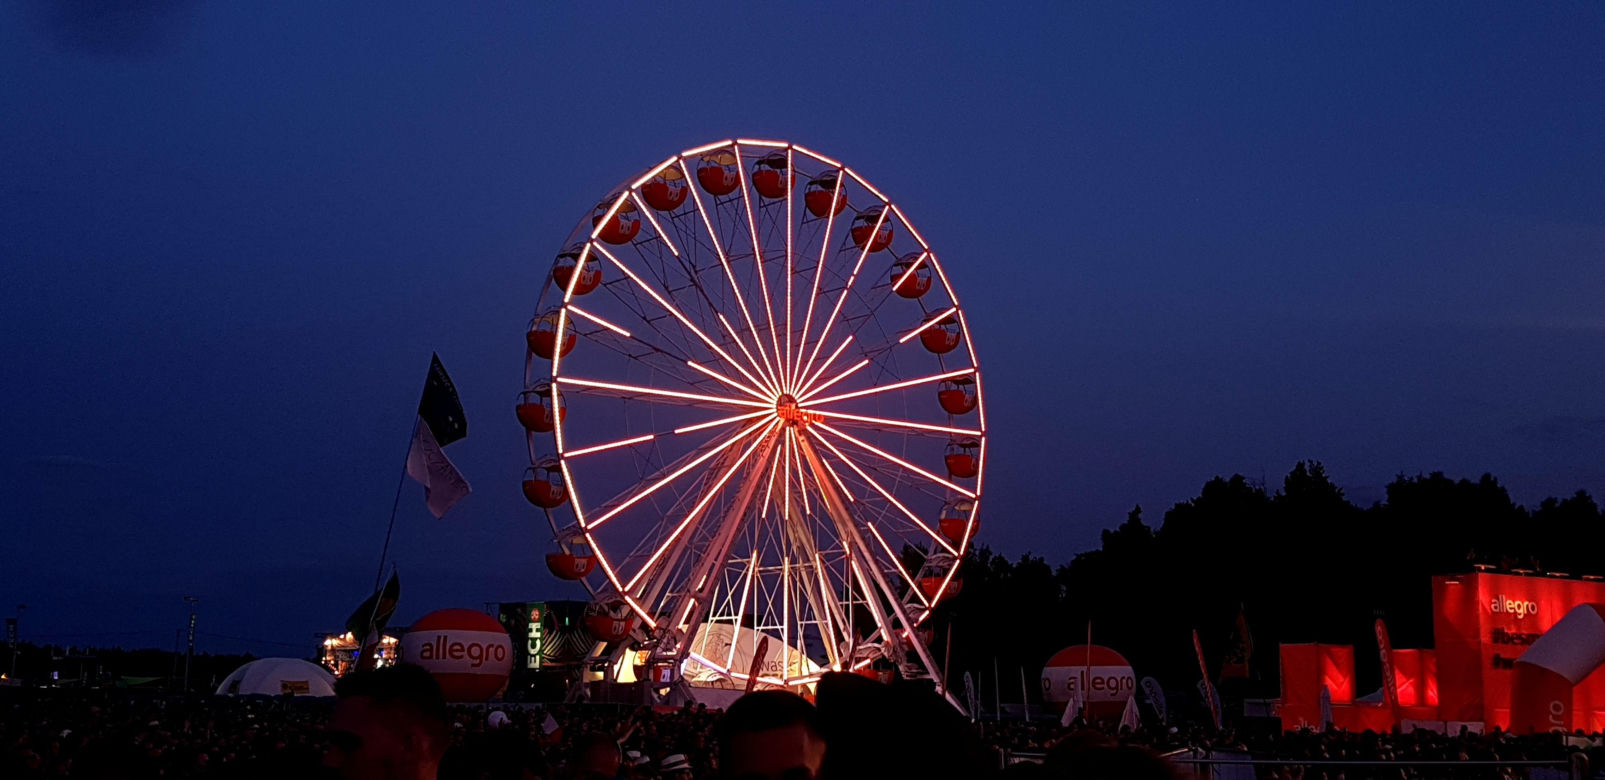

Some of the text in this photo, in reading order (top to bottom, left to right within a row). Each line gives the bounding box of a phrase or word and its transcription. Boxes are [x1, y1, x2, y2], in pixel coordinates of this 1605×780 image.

[1491, 594, 1538, 619] allegro
[420, 635, 506, 668] allegro
[527, 622, 541, 669] ECH
[1067, 670, 1134, 697] alegro
